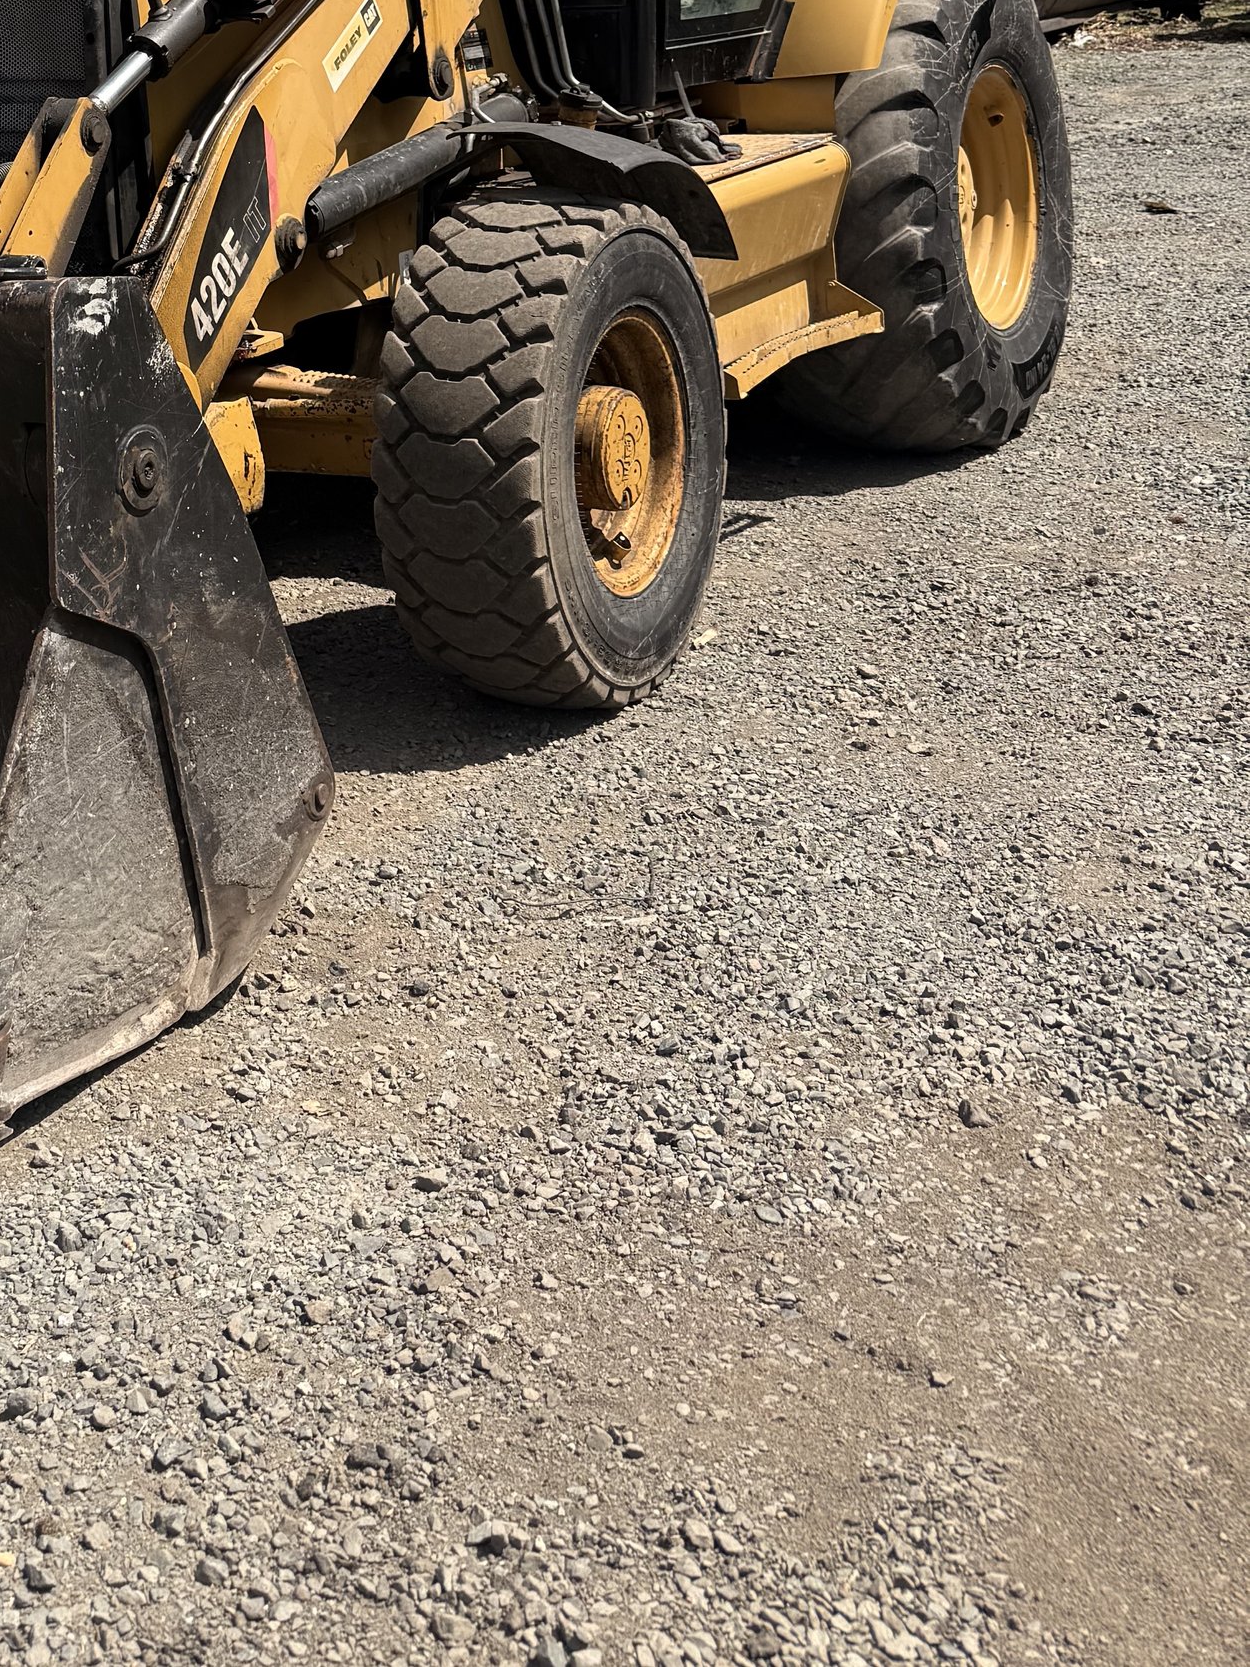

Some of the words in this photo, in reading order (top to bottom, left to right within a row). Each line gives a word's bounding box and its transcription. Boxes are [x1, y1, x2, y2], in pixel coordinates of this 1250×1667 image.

[333, 25, 362, 71] FOLEY
[363, 3, 378, 28] CAT
[190, 226, 250, 342] 420E
[242, 195, 267, 244] IT
